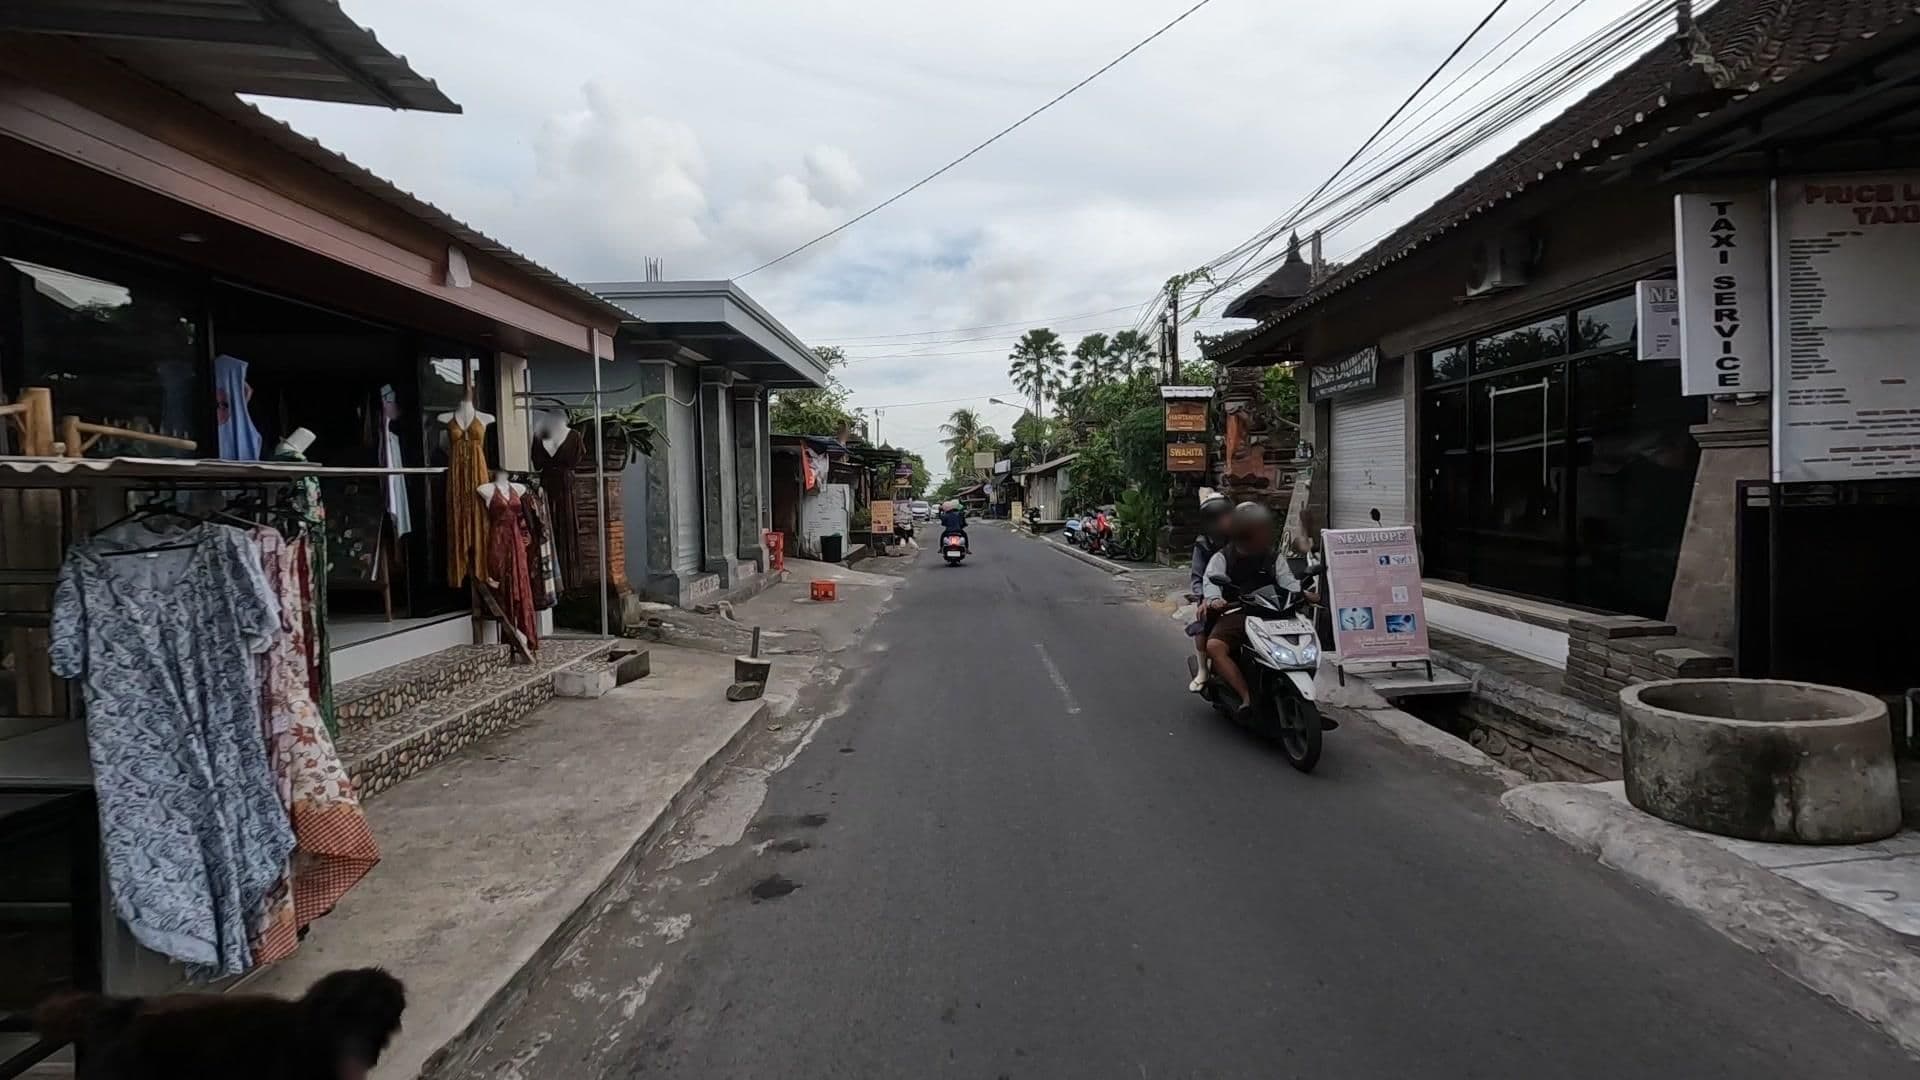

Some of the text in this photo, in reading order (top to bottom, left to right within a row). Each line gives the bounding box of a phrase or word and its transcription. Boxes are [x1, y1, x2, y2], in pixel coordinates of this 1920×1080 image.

[1805, 184, 1894, 205] PRICE
[1709, 201, 1742, 387] TAXI SERVICE
[1336, 530, 1405, 544] NEW HOPE
